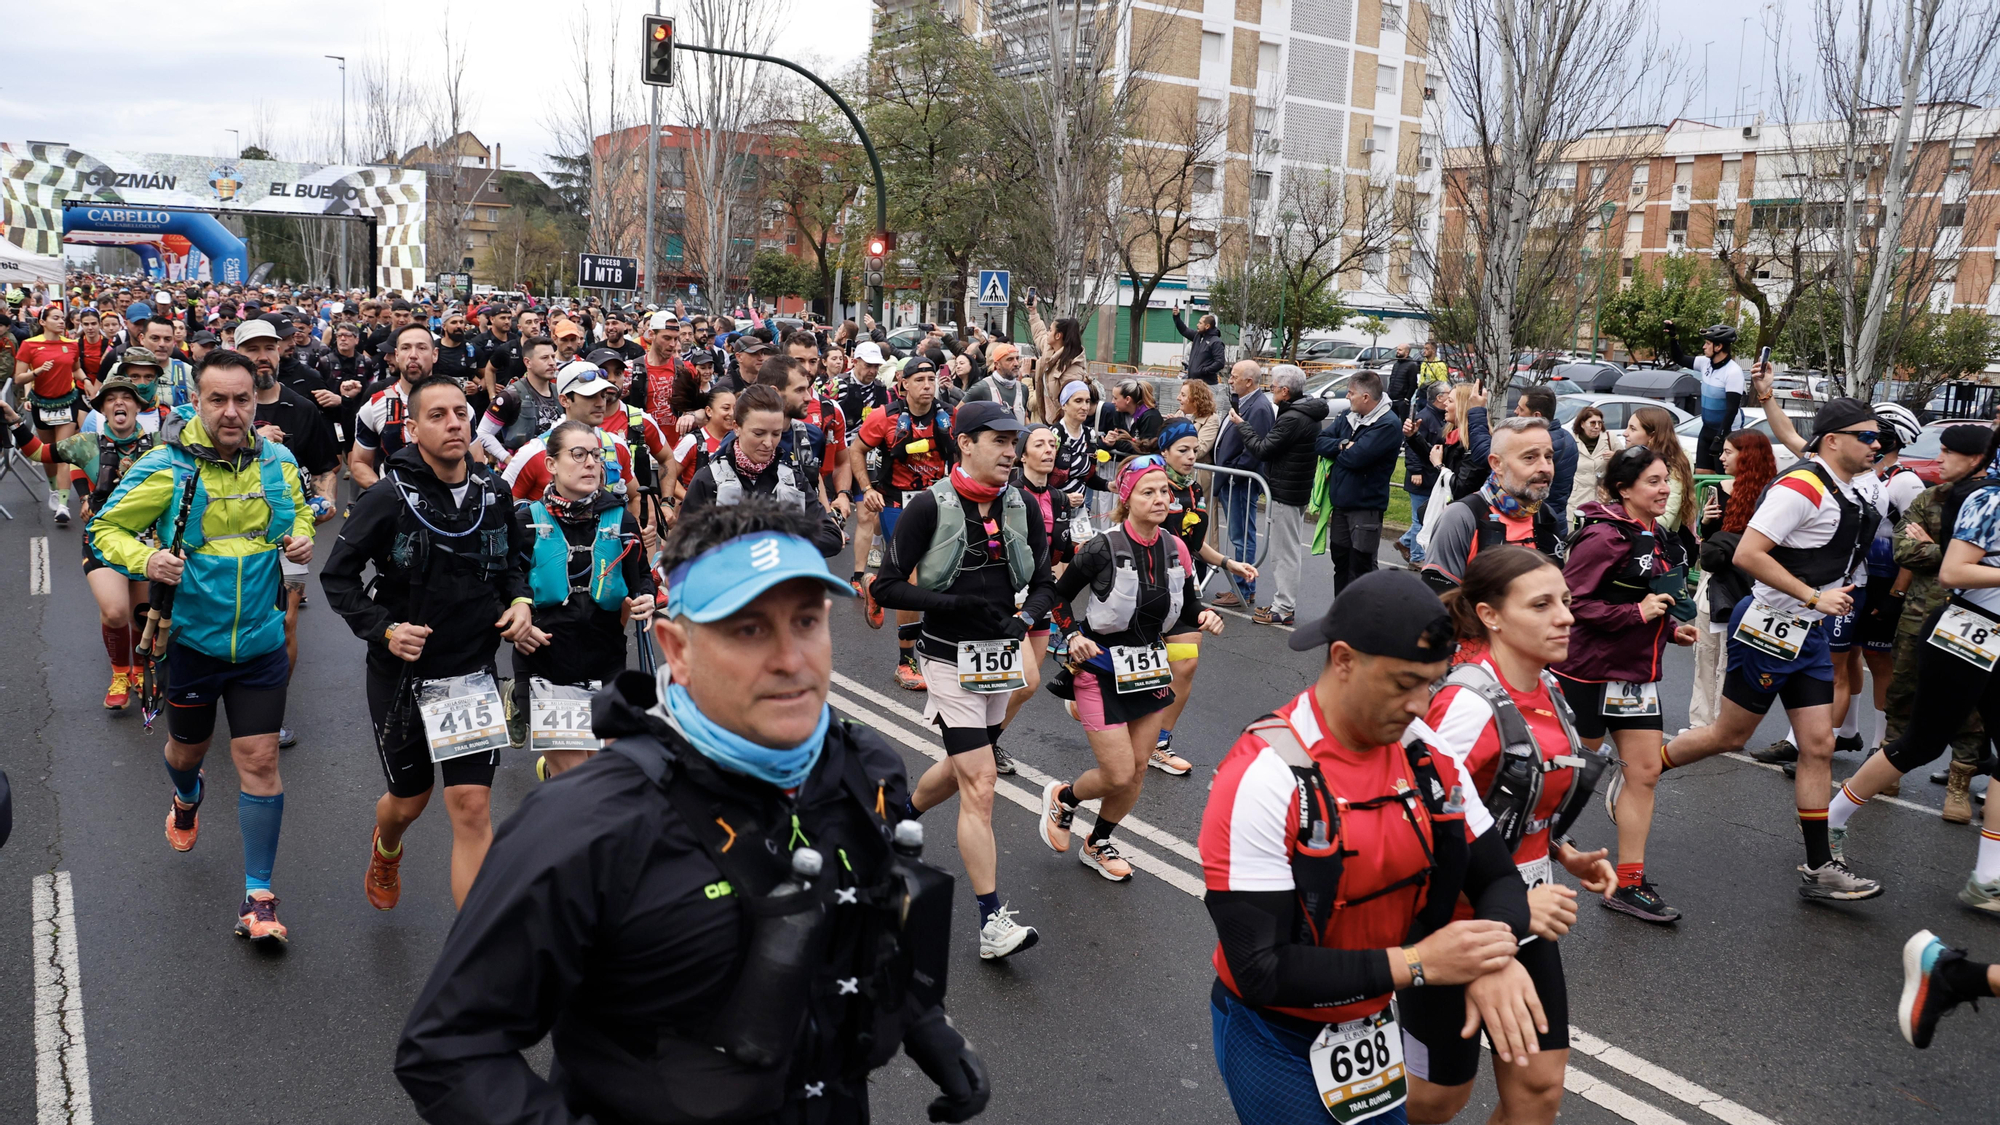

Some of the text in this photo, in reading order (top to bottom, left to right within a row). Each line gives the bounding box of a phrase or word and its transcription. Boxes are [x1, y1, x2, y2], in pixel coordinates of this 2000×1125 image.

[85, 171, 359, 201] GUZMÁN EL BUENO
[87, 209, 171, 224] CABELLO
[597, 258, 621, 267] ACCESO
[594, 266, 623, 283] MTB
[1762, 617, 1790, 639] 16
[1959, 622, 1988, 645] 18
[970, 651, 1013, 672] 150
[1124, 651, 1161, 672] 151
[439, 705, 493, 734] 415
[542, 710, 592, 730] 412
[454, 744, 469, 752] TRAIL
[1296, 775, 1309, 829] AONIJIE
[1330, 1030, 1390, 1084] 698
[1348, 1090, 1392, 1113] TRAIL RUNING
